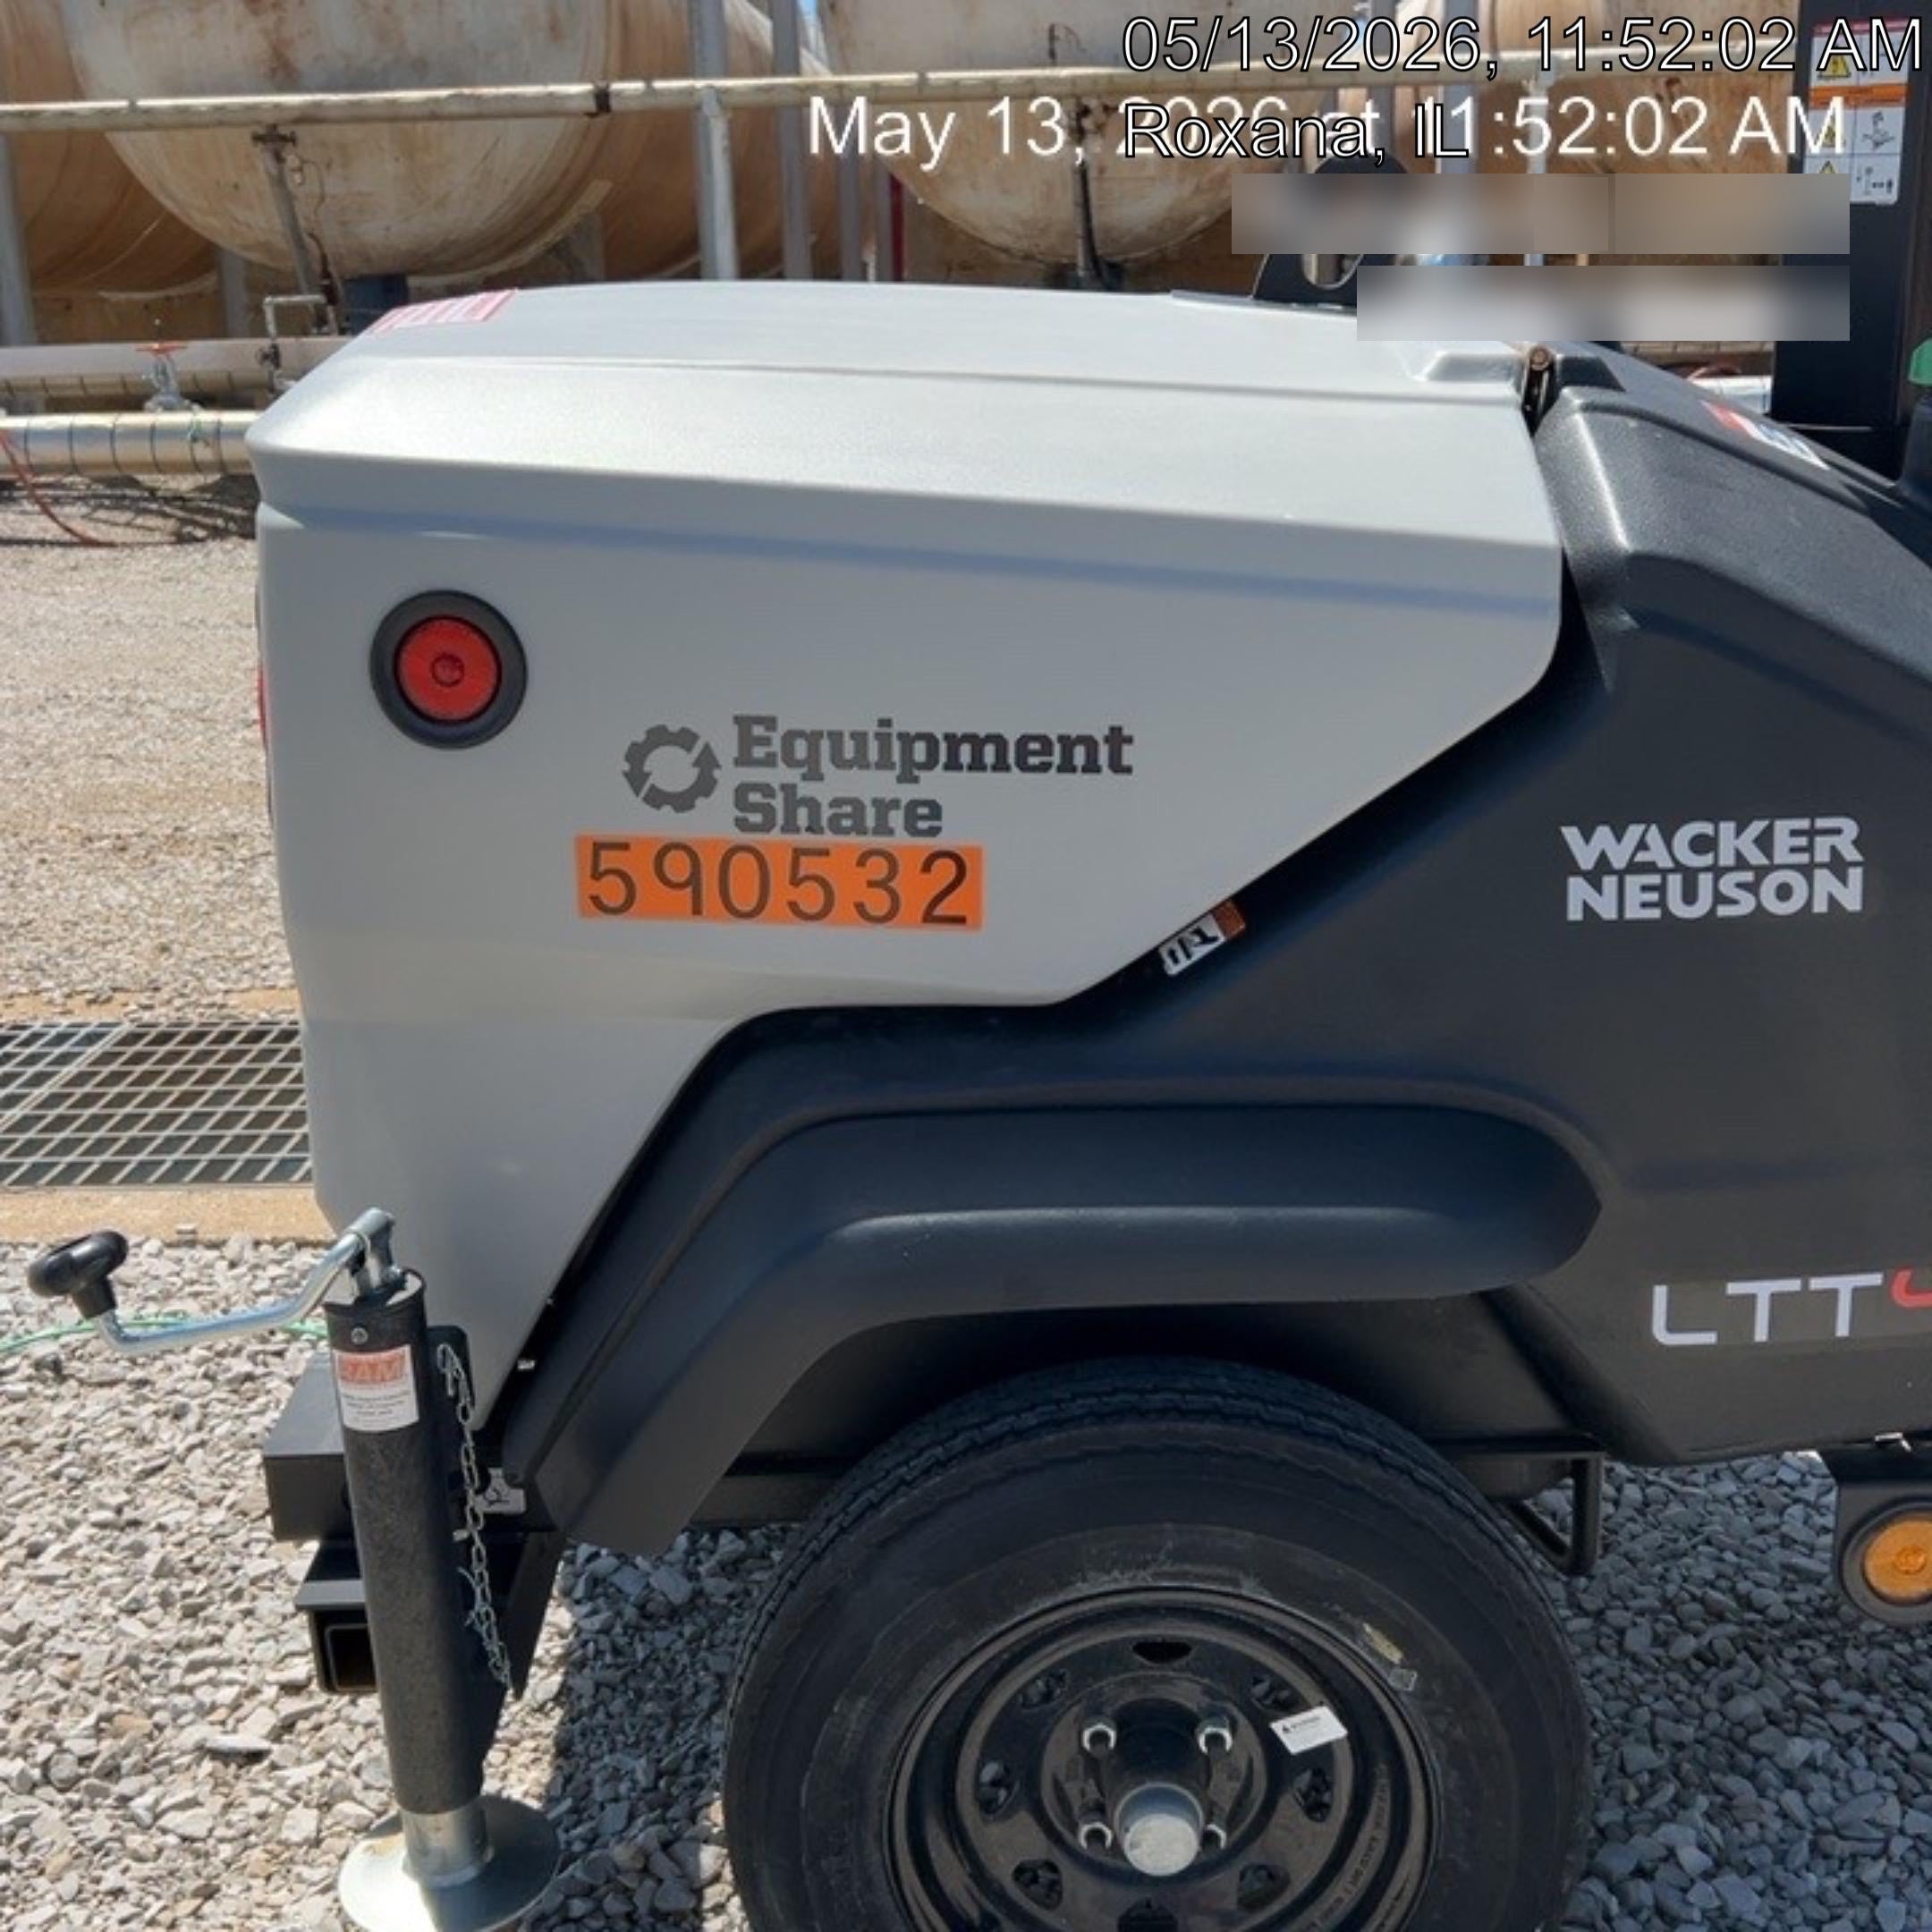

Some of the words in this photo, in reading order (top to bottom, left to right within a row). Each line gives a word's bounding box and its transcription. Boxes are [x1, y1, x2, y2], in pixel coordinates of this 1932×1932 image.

[732, 714, 1135, 784] Equipment
[733, 782, 944, 838] Share
[1559, 816, 1865, 870] WACKER
[588, 841, 969, 926] 590532
[1566, 866, 1864, 921] NEUSON
